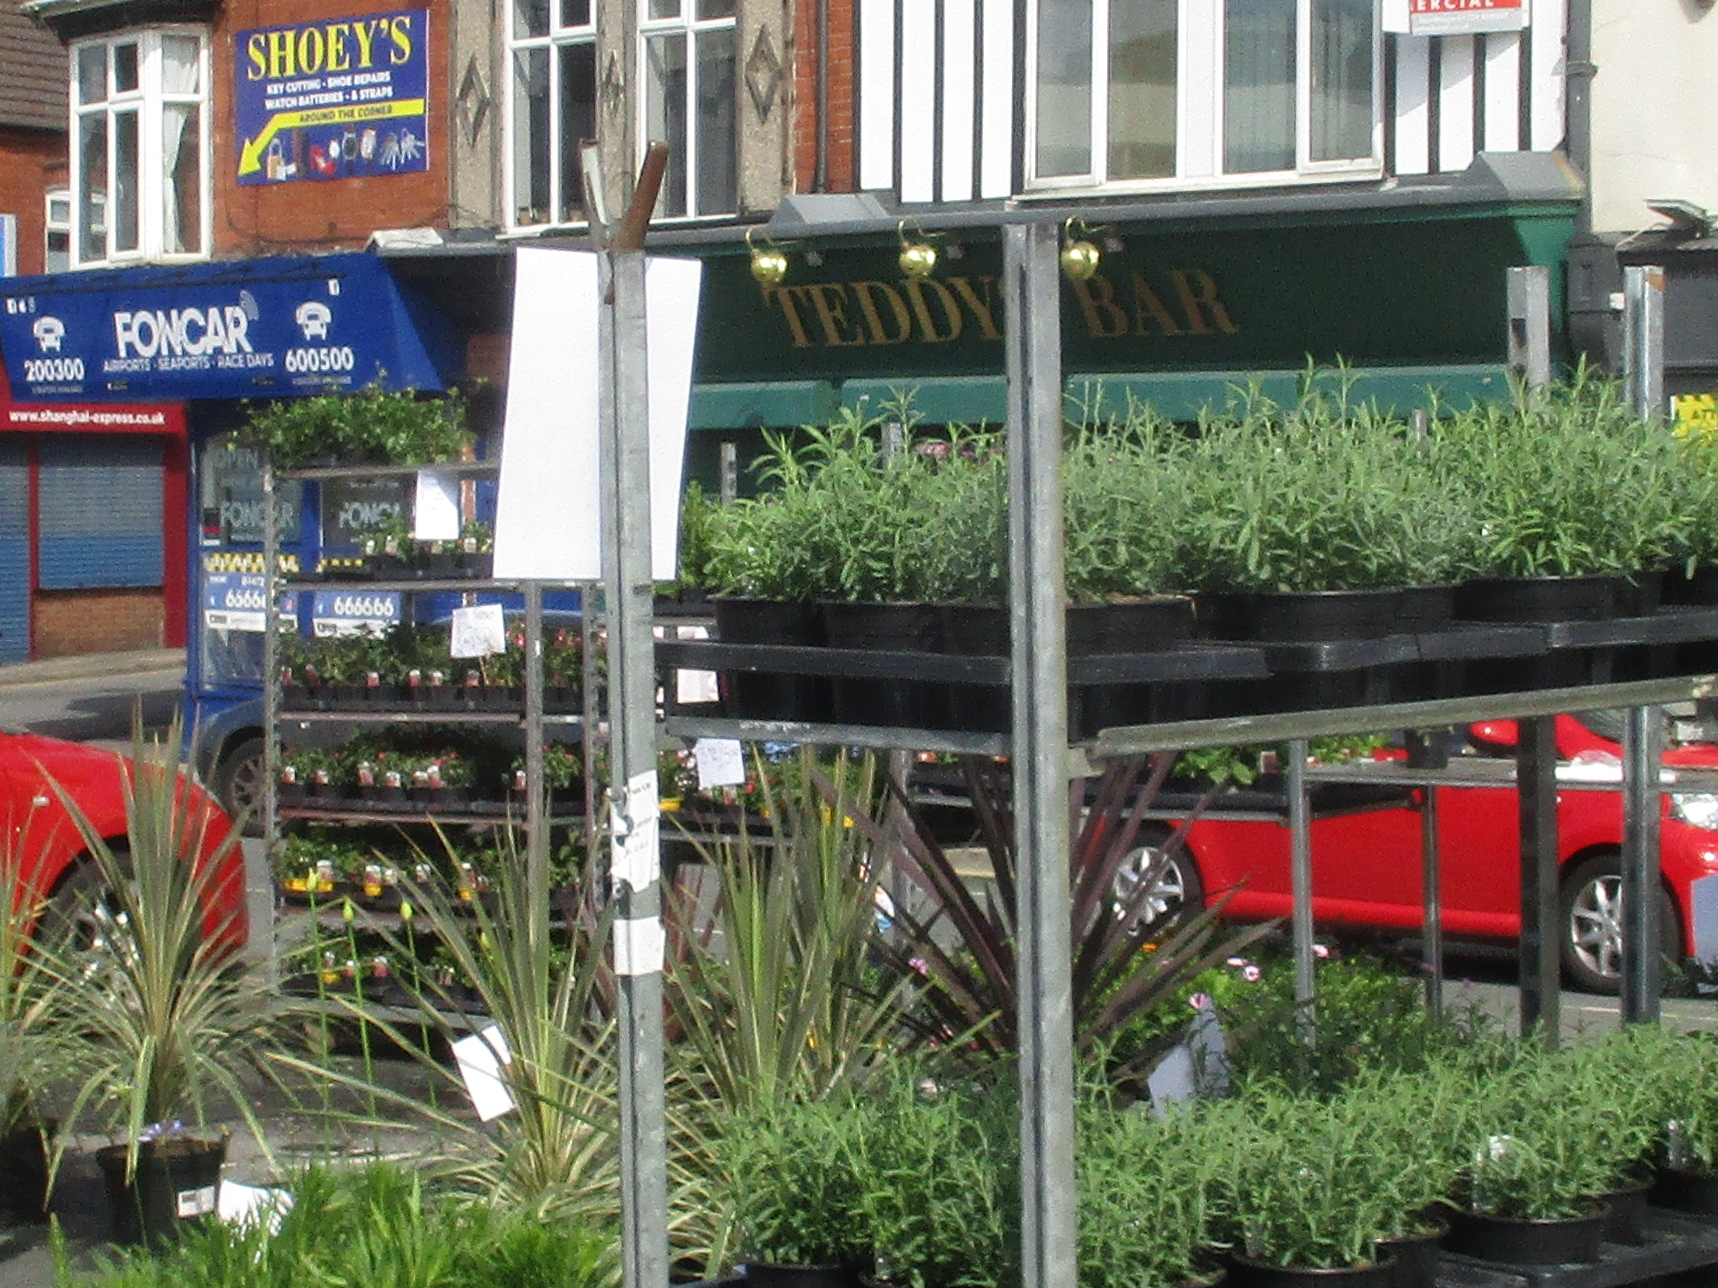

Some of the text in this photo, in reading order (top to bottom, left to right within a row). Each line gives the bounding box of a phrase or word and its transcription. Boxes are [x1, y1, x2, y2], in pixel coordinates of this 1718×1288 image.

[247, 15, 412, 81] SHOEY'S
[267, 83, 284, 96] KEY
[265, 97, 297, 110] WATCH
[299, 112, 335, 123] AROUND
[338, 109, 355, 118] THE
[1070, 267, 1240, 338] BAR
[113, 306, 255, 359] FONCAR
[23, 357, 84, 382] 200300
[102, 353, 274, 373] AIRPORTS SEAPORTS RACE DAYS
[285, 347, 354, 373] 600500
[8, 408, 166, 427] www.shanghai-express.co.uk
[333, 596, 395, 617] 666666
